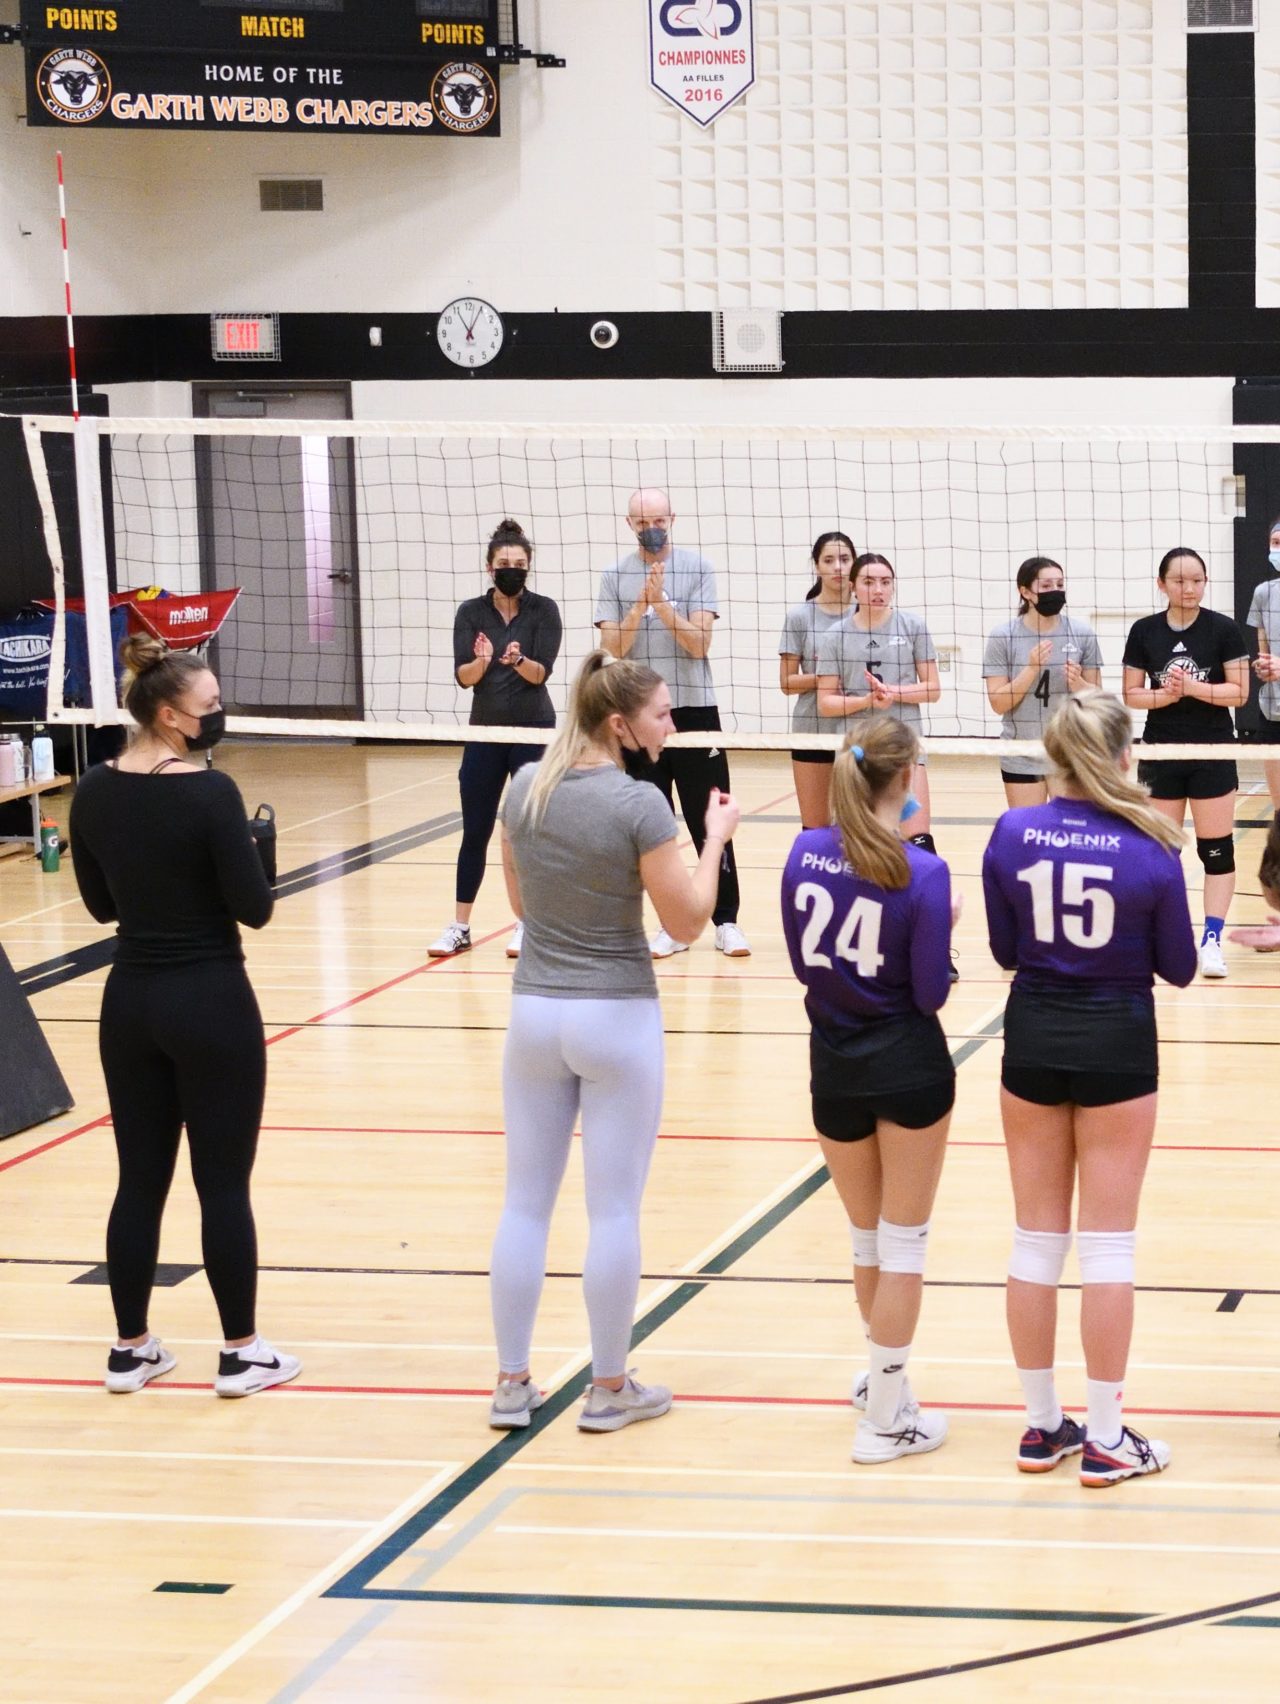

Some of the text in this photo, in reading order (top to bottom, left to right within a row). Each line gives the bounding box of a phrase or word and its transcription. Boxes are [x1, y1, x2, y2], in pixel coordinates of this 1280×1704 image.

[46, 8, 118, 31] POINTS
[241, 16, 305, 38] MATCH
[421, 23, 485, 45] POINTS
[49, 49, 74, 65] GARTH
[658, 49, 747, 66] CHAMPIONNES
[204, 65, 343, 85] HOME OF THE
[682, 74, 725, 82] AA FILLES
[684, 88, 723, 102] 2016
[46, 98, 104, 120] CHARGERS
[111, 92, 433, 128] GARTH WEBB CHARGERS
[439, 109, 490, 130] CHARGERS
[465, 302, 473, 311] 12
[445, 316, 452, 325] 10
[489, 315, 494, 324] 2
[225, 322, 259, 350] EXIT
[442, 330, 447, 338] 9
[494, 328, 499, 337] 3
[447, 343, 452, 351] 8
[491, 342, 495, 350] 4
[457, 352, 461, 361] 7
[469, 355, 474, 363] 6
[482, 351, 487, 360] 5
[169, 606, 209, 626] molten
[1034, 669, 1051, 708] 4
[48, 836, 59, 848] G
[1023, 828, 1121, 849] PHOENIX
[801, 852, 857, 875] PHOE
[1016, 859, 1115, 949] 15
[794, 881, 885, 978] 24
